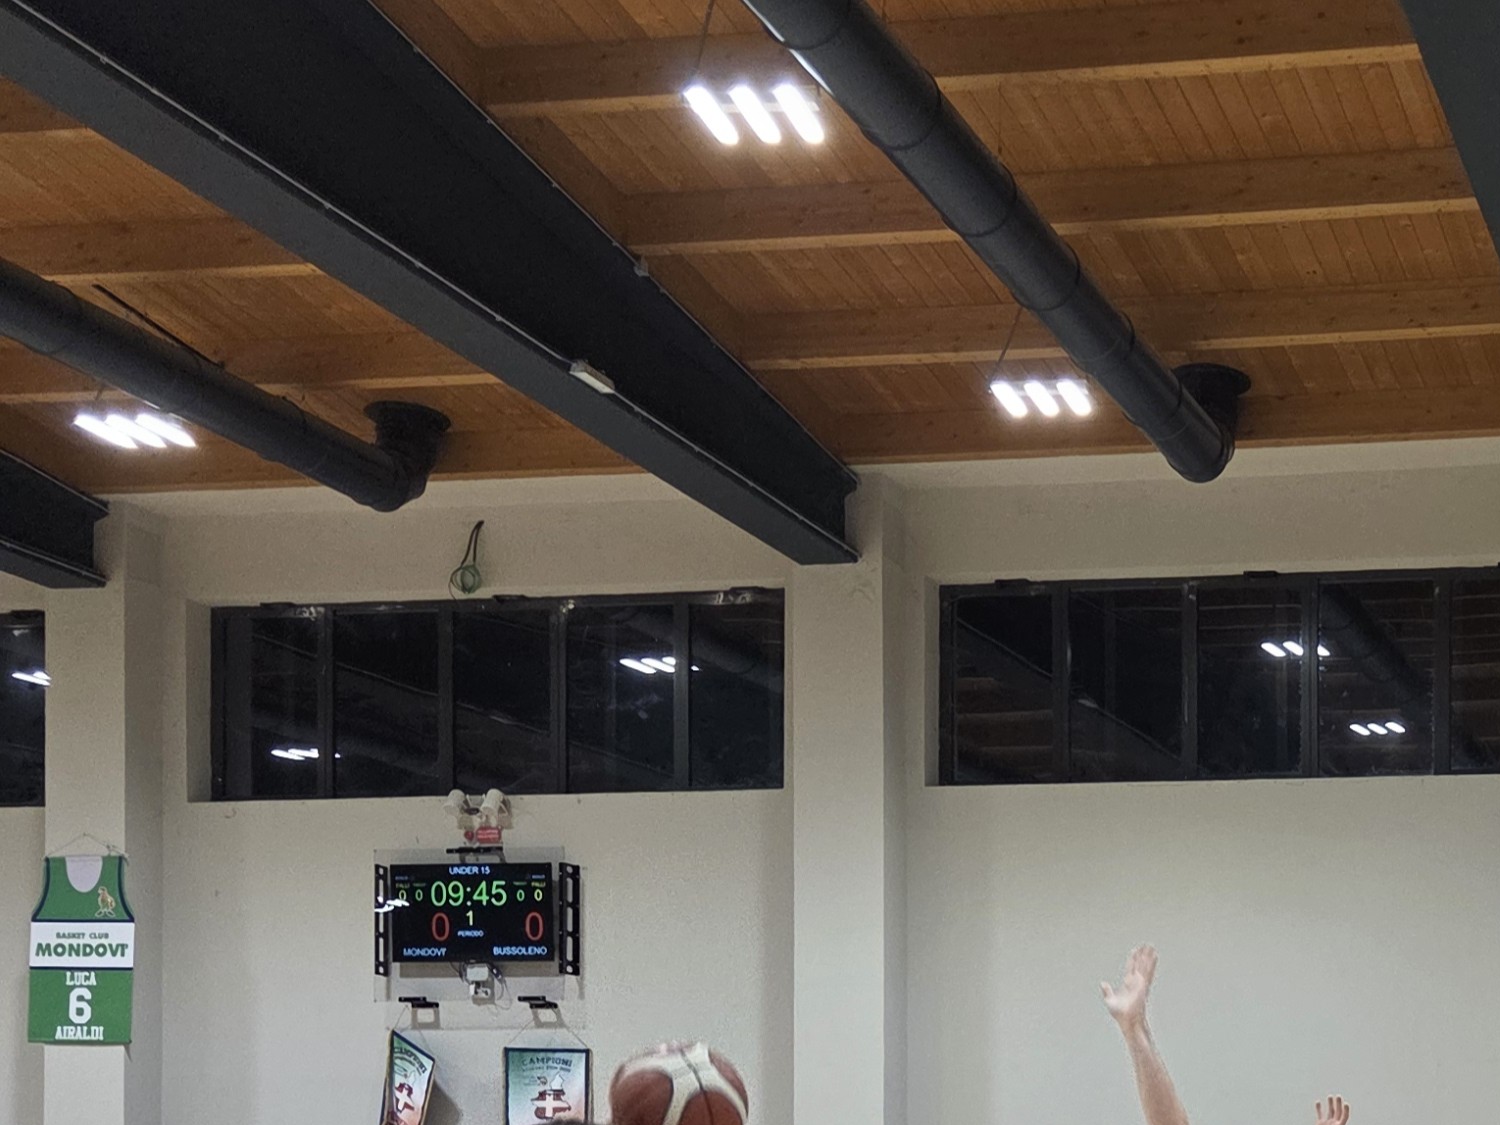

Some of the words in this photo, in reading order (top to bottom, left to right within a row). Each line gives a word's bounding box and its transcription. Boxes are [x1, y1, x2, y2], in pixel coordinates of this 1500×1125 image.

[449, 866, 479, 875] UNDER
[481, 866, 490, 875] 15
[415, 889, 424, 901] 0
[431, 880, 507, 907] 09:45
[516, 889, 525, 902] 0
[533, 889, 543, 902] 0
[466, 910, 474, 926] 1
[432, 912, 450, 942] 0
[525, 911, 544, 942] 0
[56, 932, 86, 940] BASKET
[89, 932, 109, 940] CLUB
[493, 945, 548, 956] BUSSOLENO
[66, 971, 97, 986] LUCA
[68, 987, 92, 1025] 6
[55, 1025, 104, 1041] AIRALDI
[521, 1056, 573, 1068] CAMPIONI
